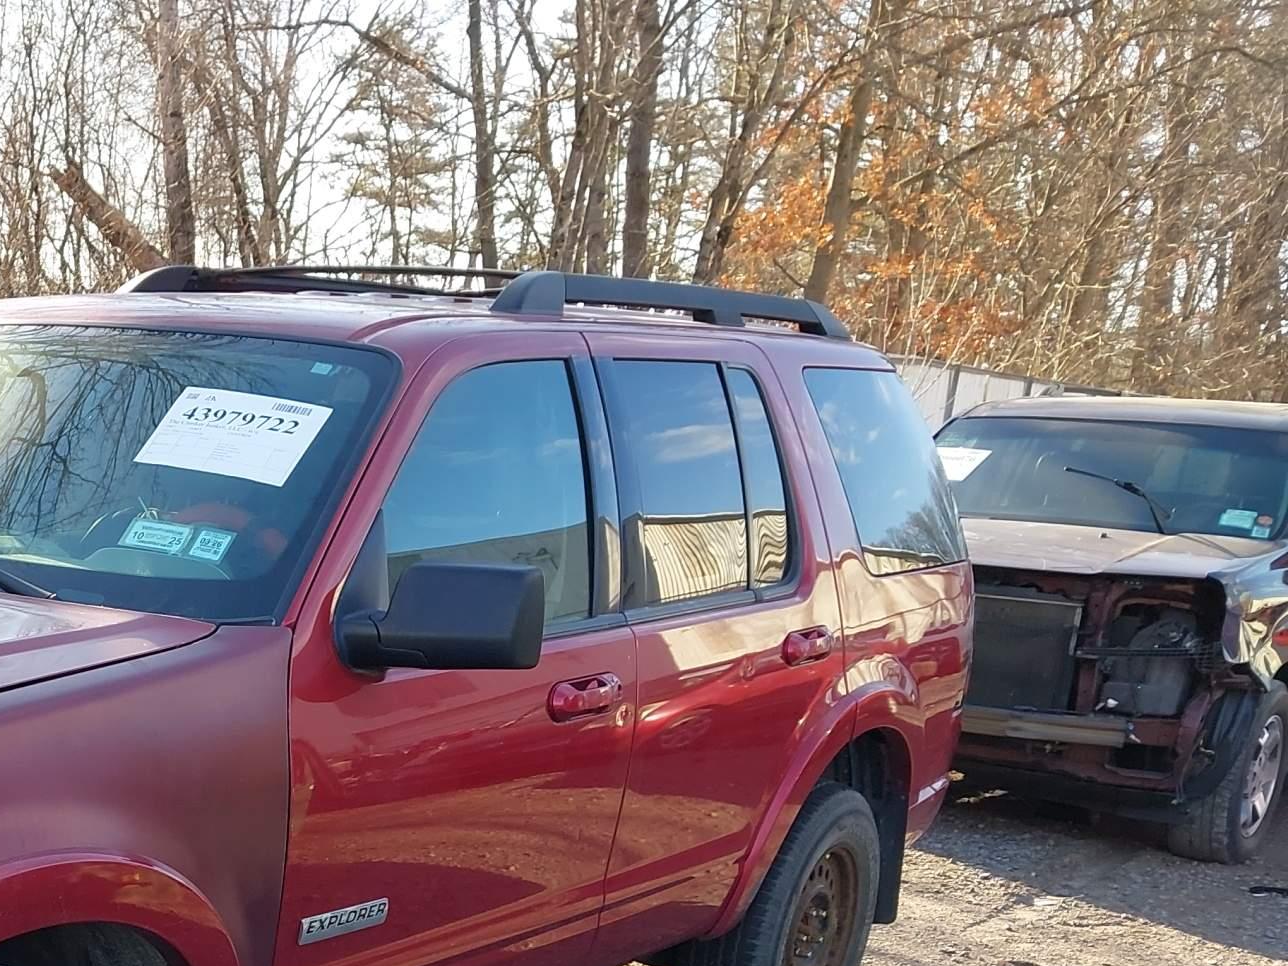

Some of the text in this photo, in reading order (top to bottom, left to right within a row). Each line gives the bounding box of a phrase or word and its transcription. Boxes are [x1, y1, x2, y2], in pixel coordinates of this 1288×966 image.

[182, 406, 299, 434] 43979722
[168, 537, 183, 546] 25
[306, 902, 387, 934] EXPLORER
